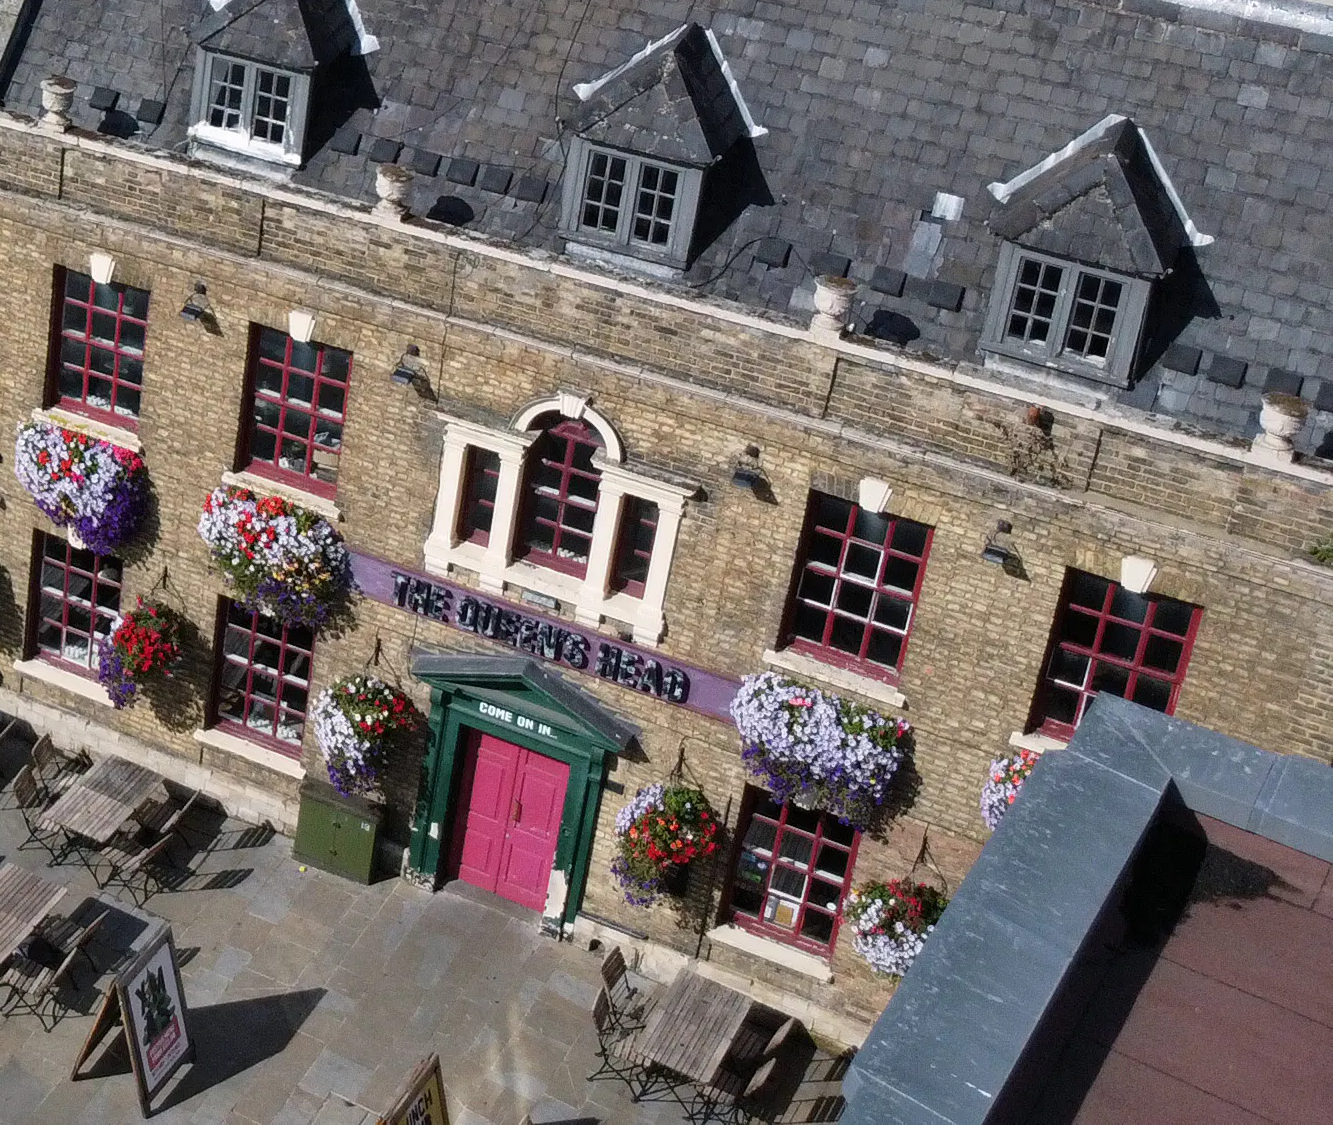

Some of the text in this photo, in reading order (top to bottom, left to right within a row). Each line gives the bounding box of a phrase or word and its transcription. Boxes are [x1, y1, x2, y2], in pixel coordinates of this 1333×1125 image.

[391, 570, 454, 624] THE
[594, 640, 691, 704] HEAD
[479, 701, 513, 724] COME
[516, 715, 534, 731] ON
